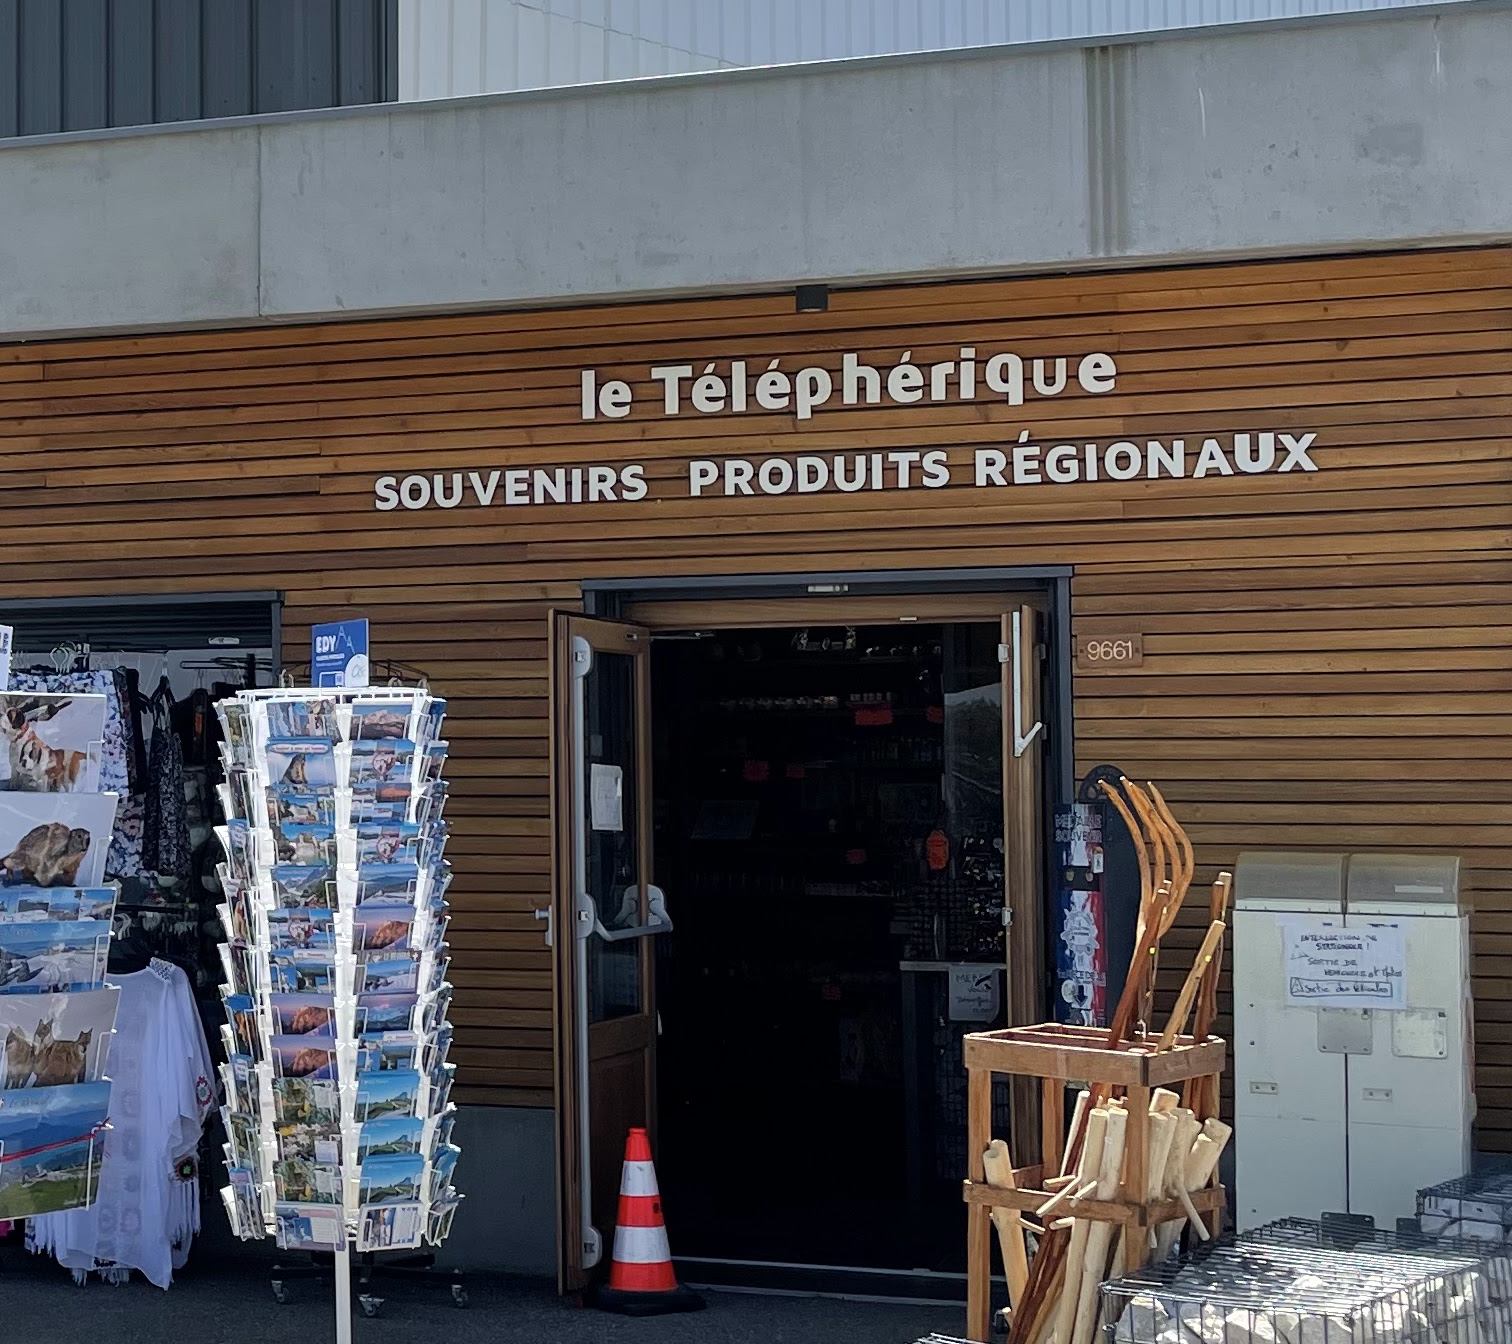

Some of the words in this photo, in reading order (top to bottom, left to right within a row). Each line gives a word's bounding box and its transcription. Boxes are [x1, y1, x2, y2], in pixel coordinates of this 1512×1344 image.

[582, 369, 633, 420] le
[651, 347, 1117, 420] Téléphérique
[375, 464, 648, 510] SOUVENIRS
[689, 450, 951, 496] PRODUITS
[975, 430, 1319, 488] RÉGIONAUX
[1087, 640, 1133, 661] 9661
